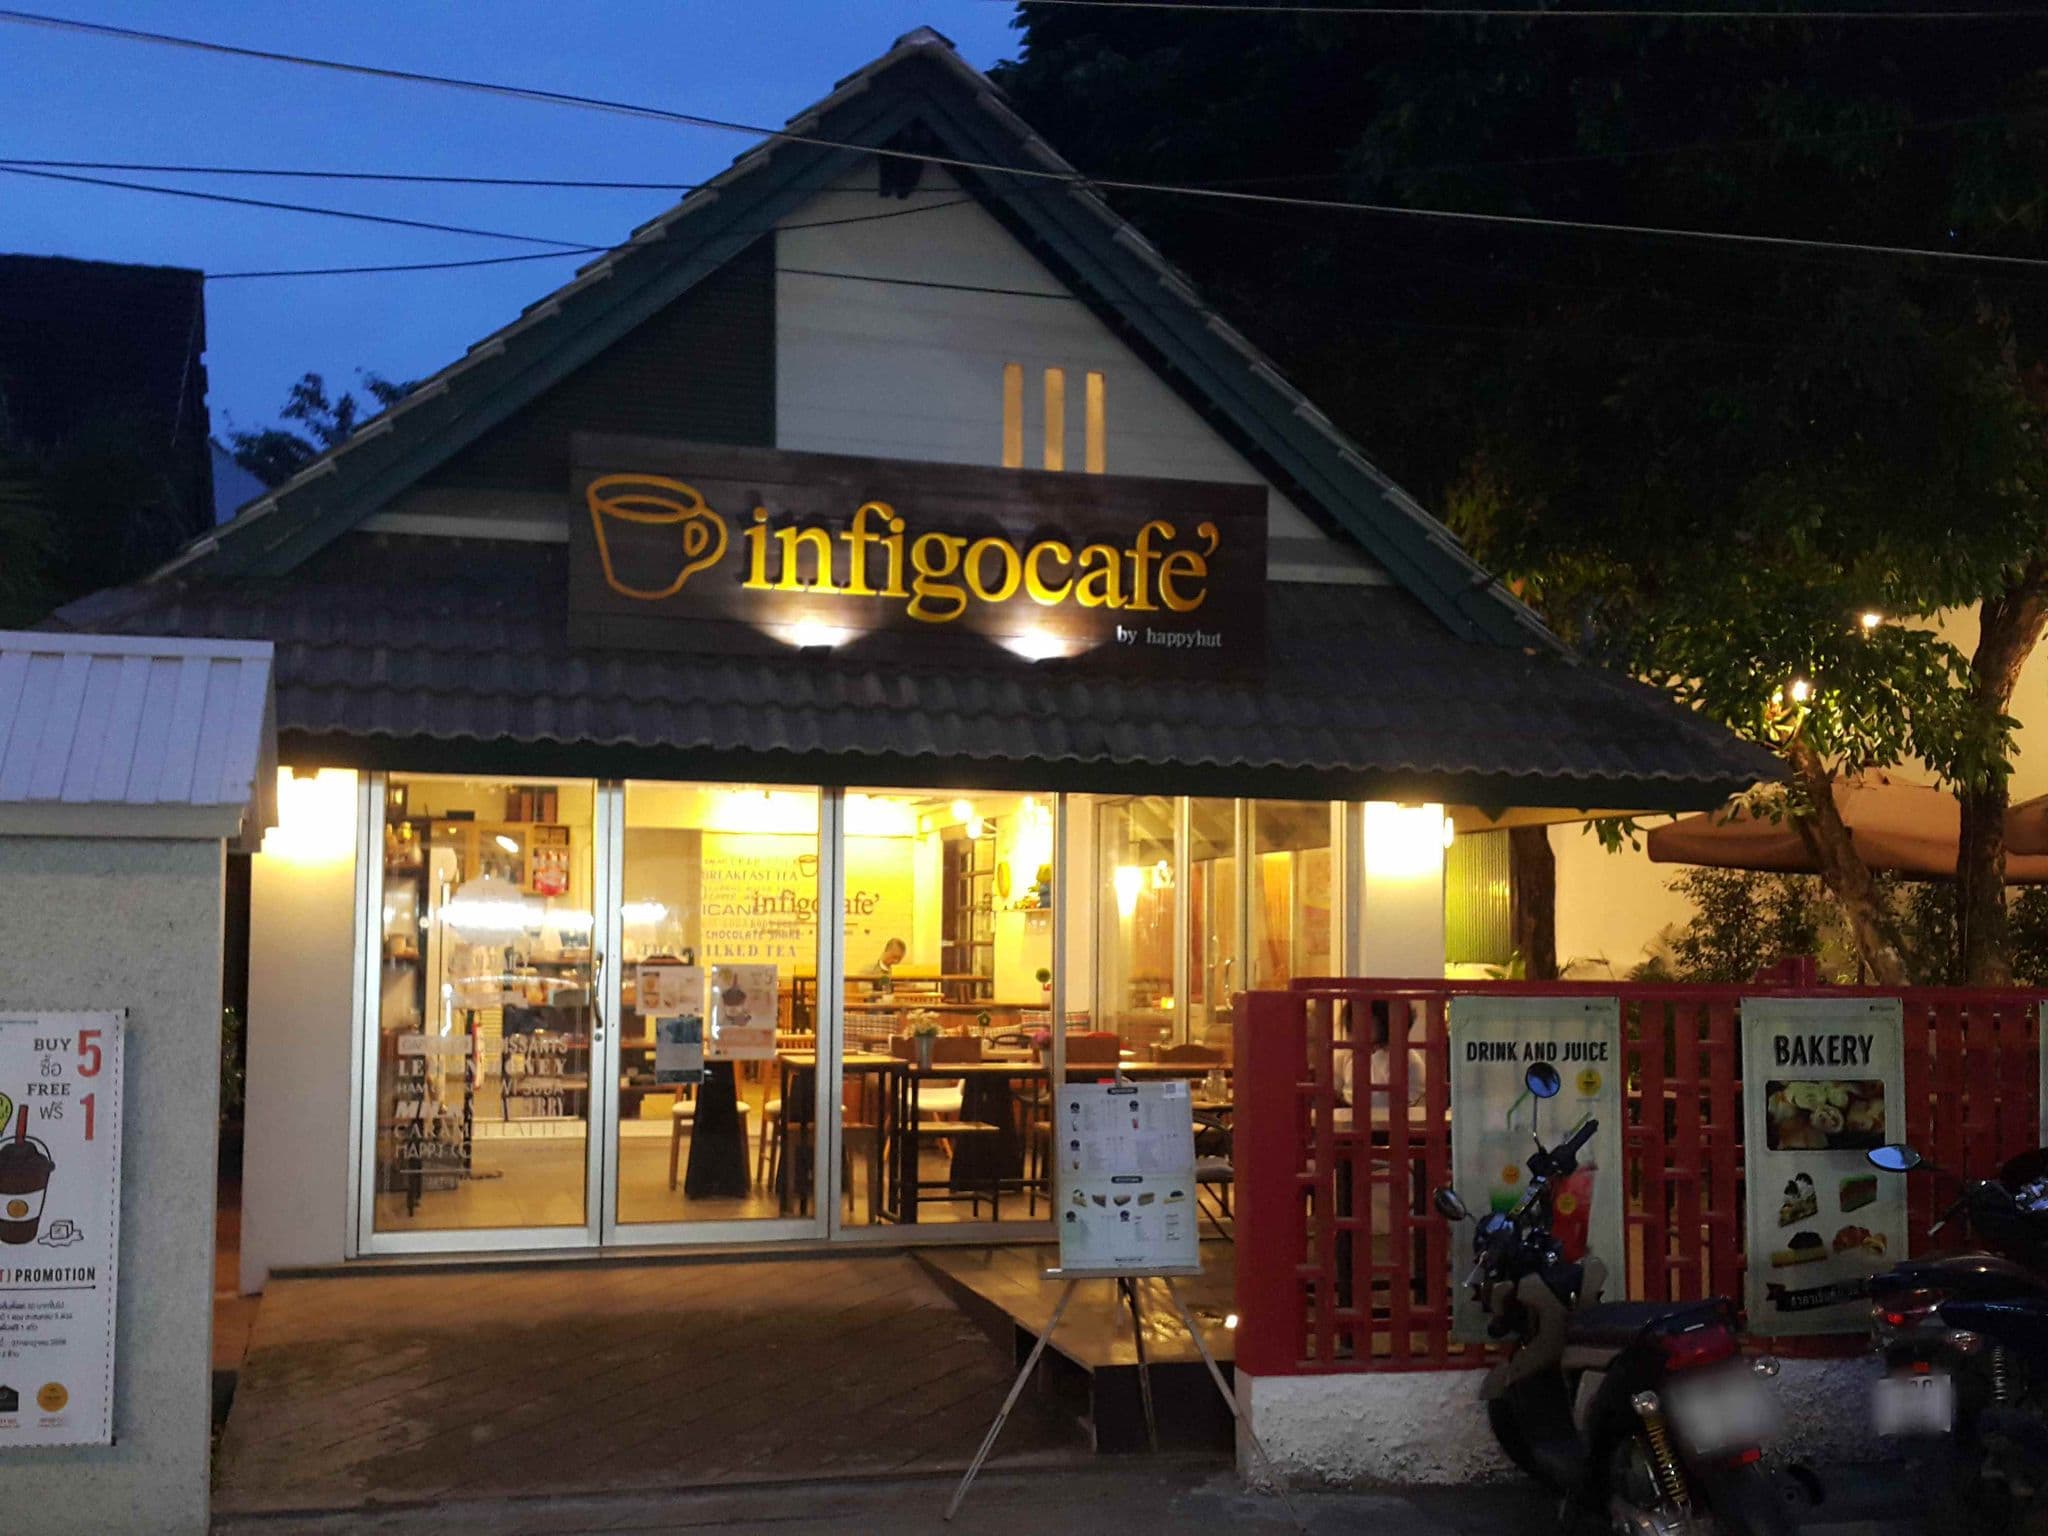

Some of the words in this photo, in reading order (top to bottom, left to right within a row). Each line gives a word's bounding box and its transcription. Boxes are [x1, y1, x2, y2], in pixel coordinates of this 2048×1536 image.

[1115, 624, 1138, 645] by
[1146, 626, 1224, 648] happyhut
[33, 1037, 72, 1052] BUY
[77, 1029, 103, 1078] 5
[1466, 1041, 1517, 1062] DRINK
[1522, 1041, 1558, 1062] AND
[1561, 1041, 1609, 1062] JUICE
[1773, 1034, 1874, 1067] BAKERY
[40, 1054, 63, 1077] ซื้อ
[26, 1082, 72, 1097] FREE
[79, 1092, 95, 1142] 1
[39, 1101, 64, 1121] ฟรี
[15, 1266, 96, 1284] PROMOTION
